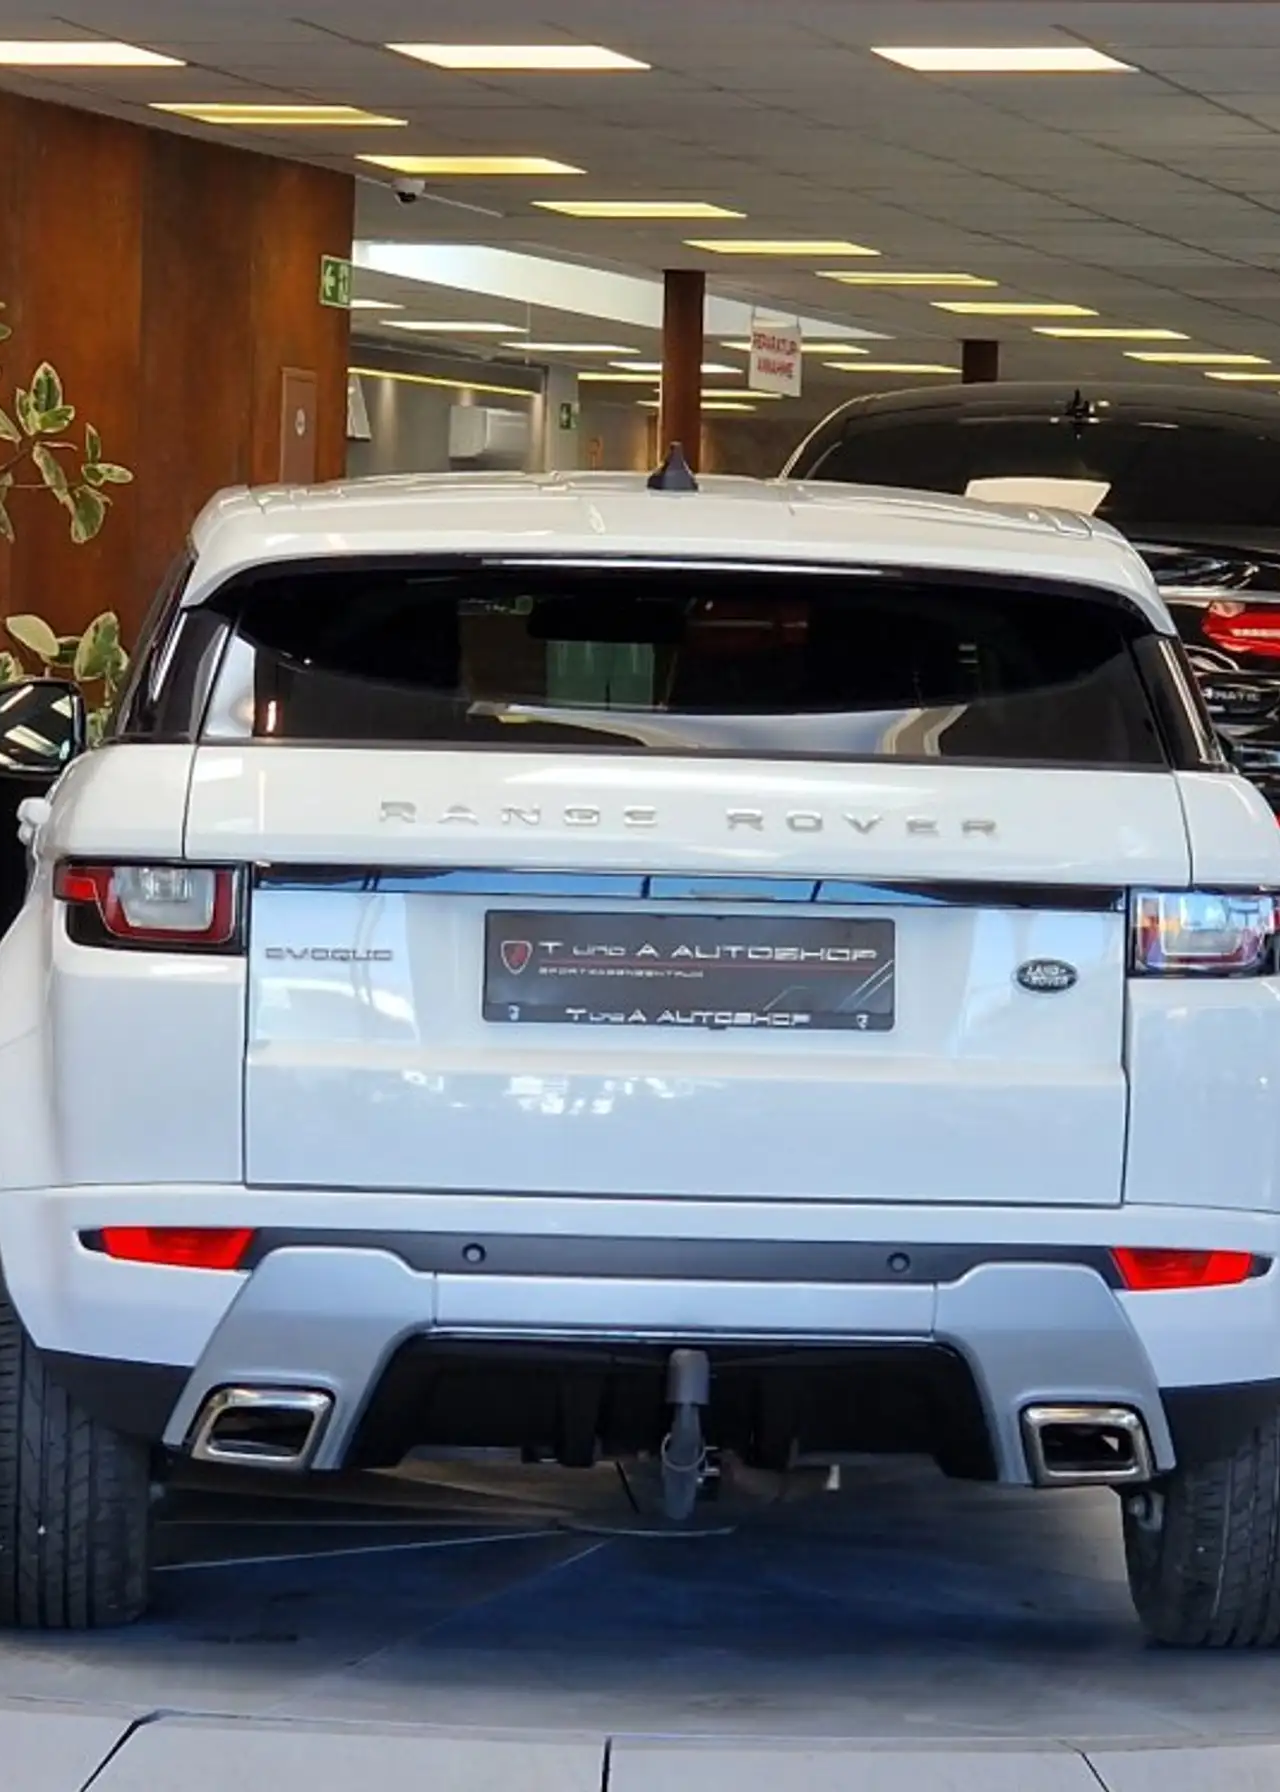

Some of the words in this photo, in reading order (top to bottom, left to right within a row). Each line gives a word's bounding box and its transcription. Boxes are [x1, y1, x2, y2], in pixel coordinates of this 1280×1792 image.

[379, 799, 659, 828] RANGE
[726, 806, 999, 839] ROVER
[264, 947, 394, 962] EVOQUE
[537, 941, 564, 955] T
[635, 944, 659, 958] A
[670, 944, 878, 962] AUTOSHOP
[565, 1007, 587, 1021] T
[628, 1009, 648, 1023] A
[656, 1010, 811, 1026] AUTOSHOP
